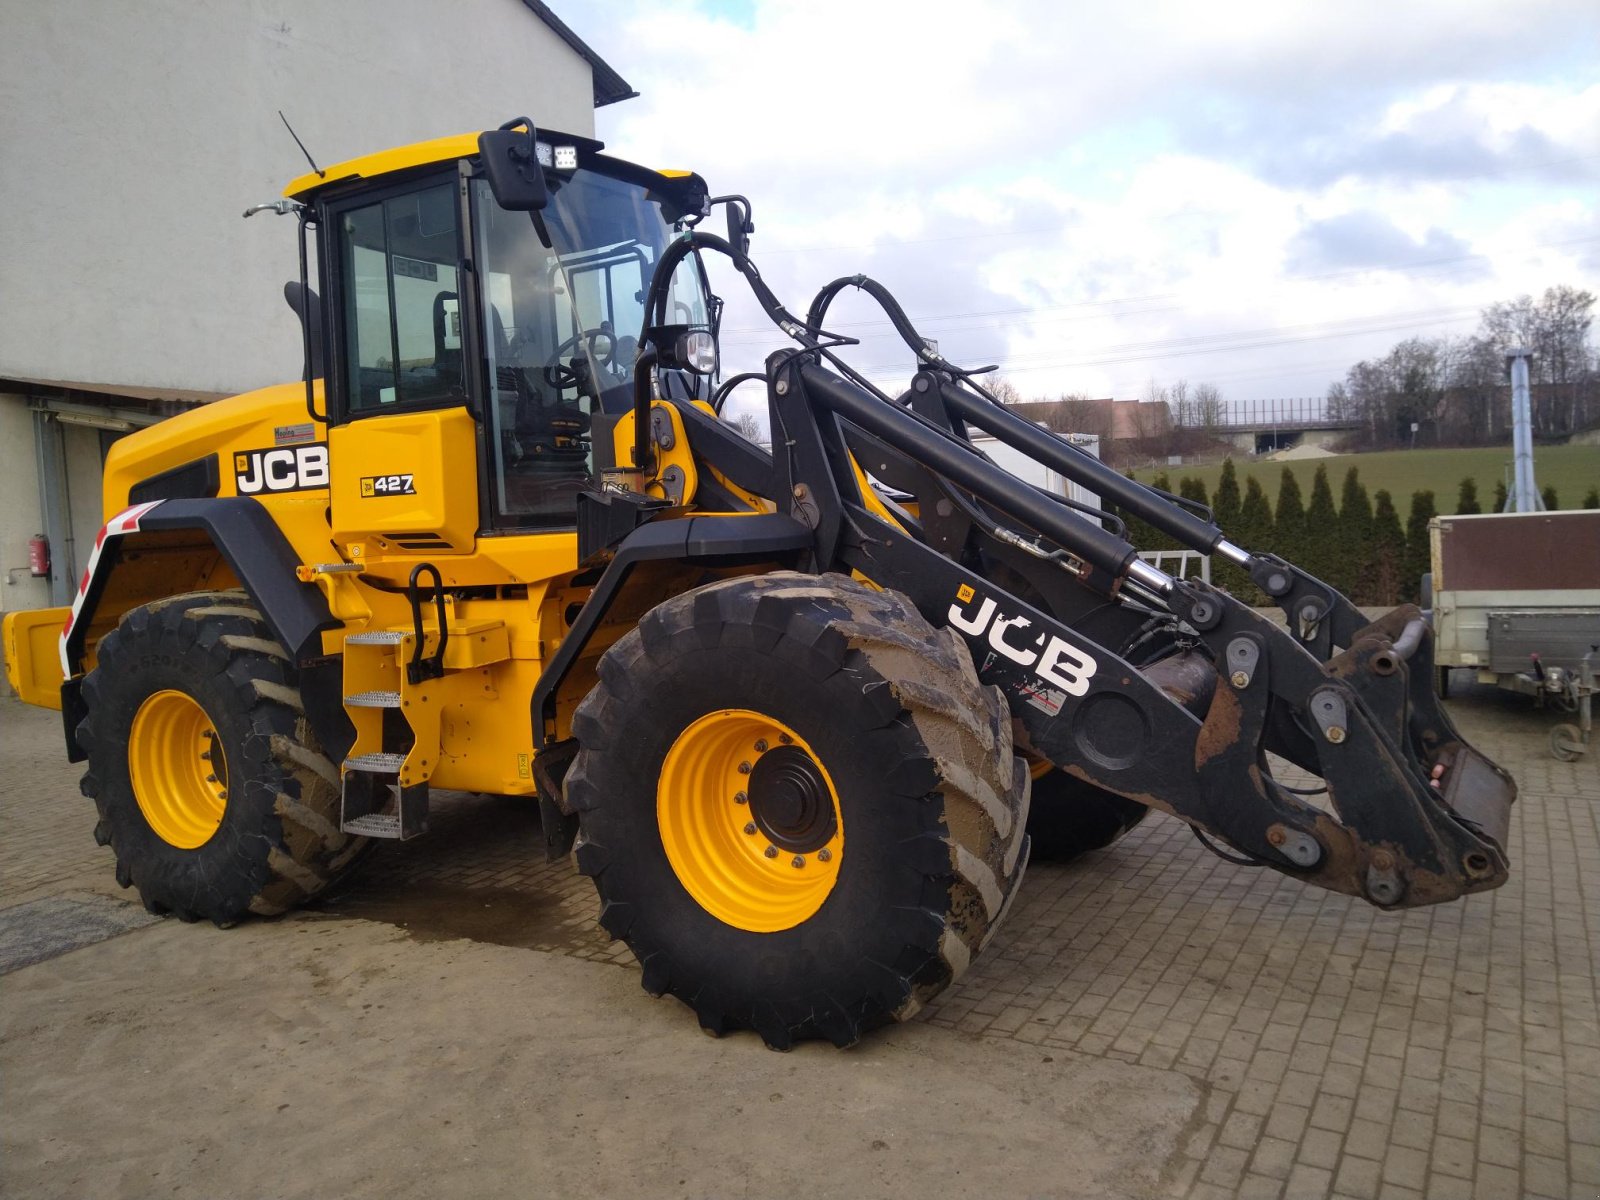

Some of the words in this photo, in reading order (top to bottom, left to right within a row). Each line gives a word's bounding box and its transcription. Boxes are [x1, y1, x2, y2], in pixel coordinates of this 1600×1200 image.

[237, 446, 329, 492] JCB
[375, 475, 413, 491] 427
[947, 597, 1098, 697] JCB
